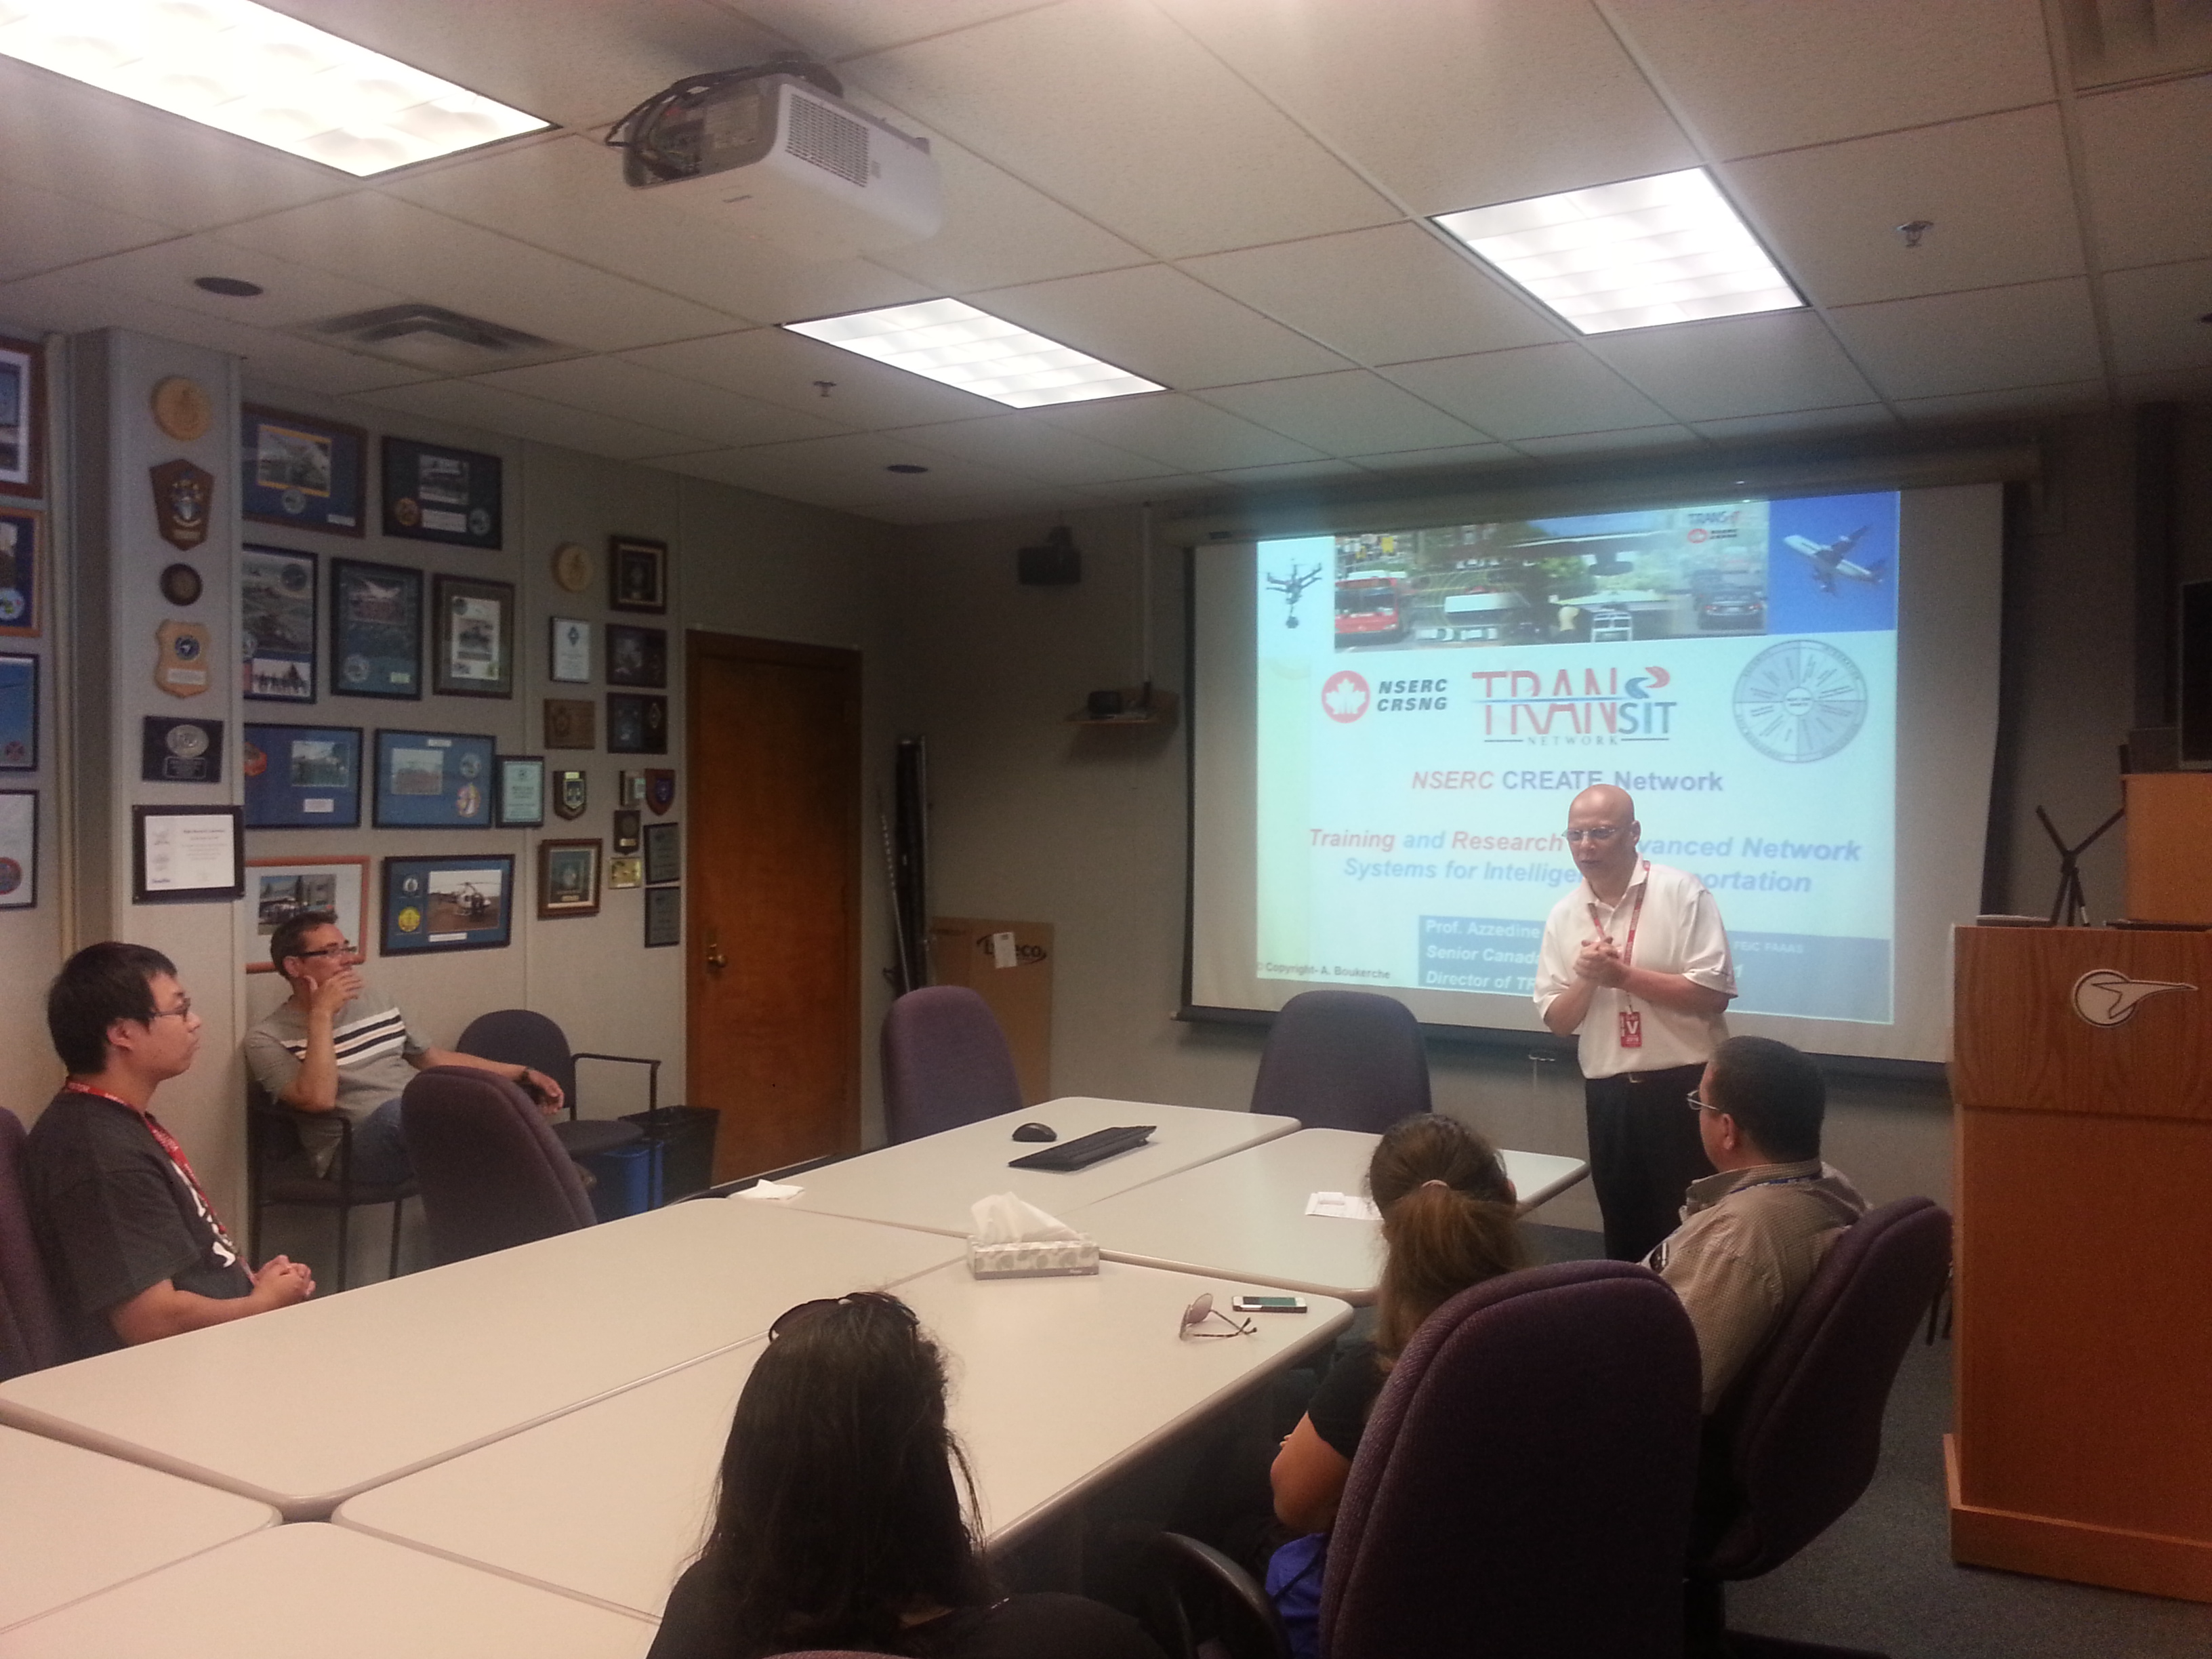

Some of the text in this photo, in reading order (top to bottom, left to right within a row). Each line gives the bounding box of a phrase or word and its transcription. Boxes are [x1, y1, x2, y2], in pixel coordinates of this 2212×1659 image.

[1378, 678, 1448, 694] NSERC
[1377, 697, 1448, 712] CRSNG
[1528, 735, 1618, 746] NETWORK
[1412, 770, 1724, 792] NSERC CREATE Network
[1309, 829, 1861, 861] Training and Research vanced Network
[1344, 857, 1437, 881] Systems
[1445, 859, 1477, 880] for
[1483, 861, 1583, 888] Intellige
[1425, 920, 1462, 935] Prof.
[1467, 922, 1540, 939] Azzedine
[1427, 945, 1479, 961] Senior
[1334, 966, 1390, 979] Boukerche
[1427, 970, 1491, 987] Director
[1494, 977, 1512, 989] of
[1626, 1021, 1639, 1034] V
